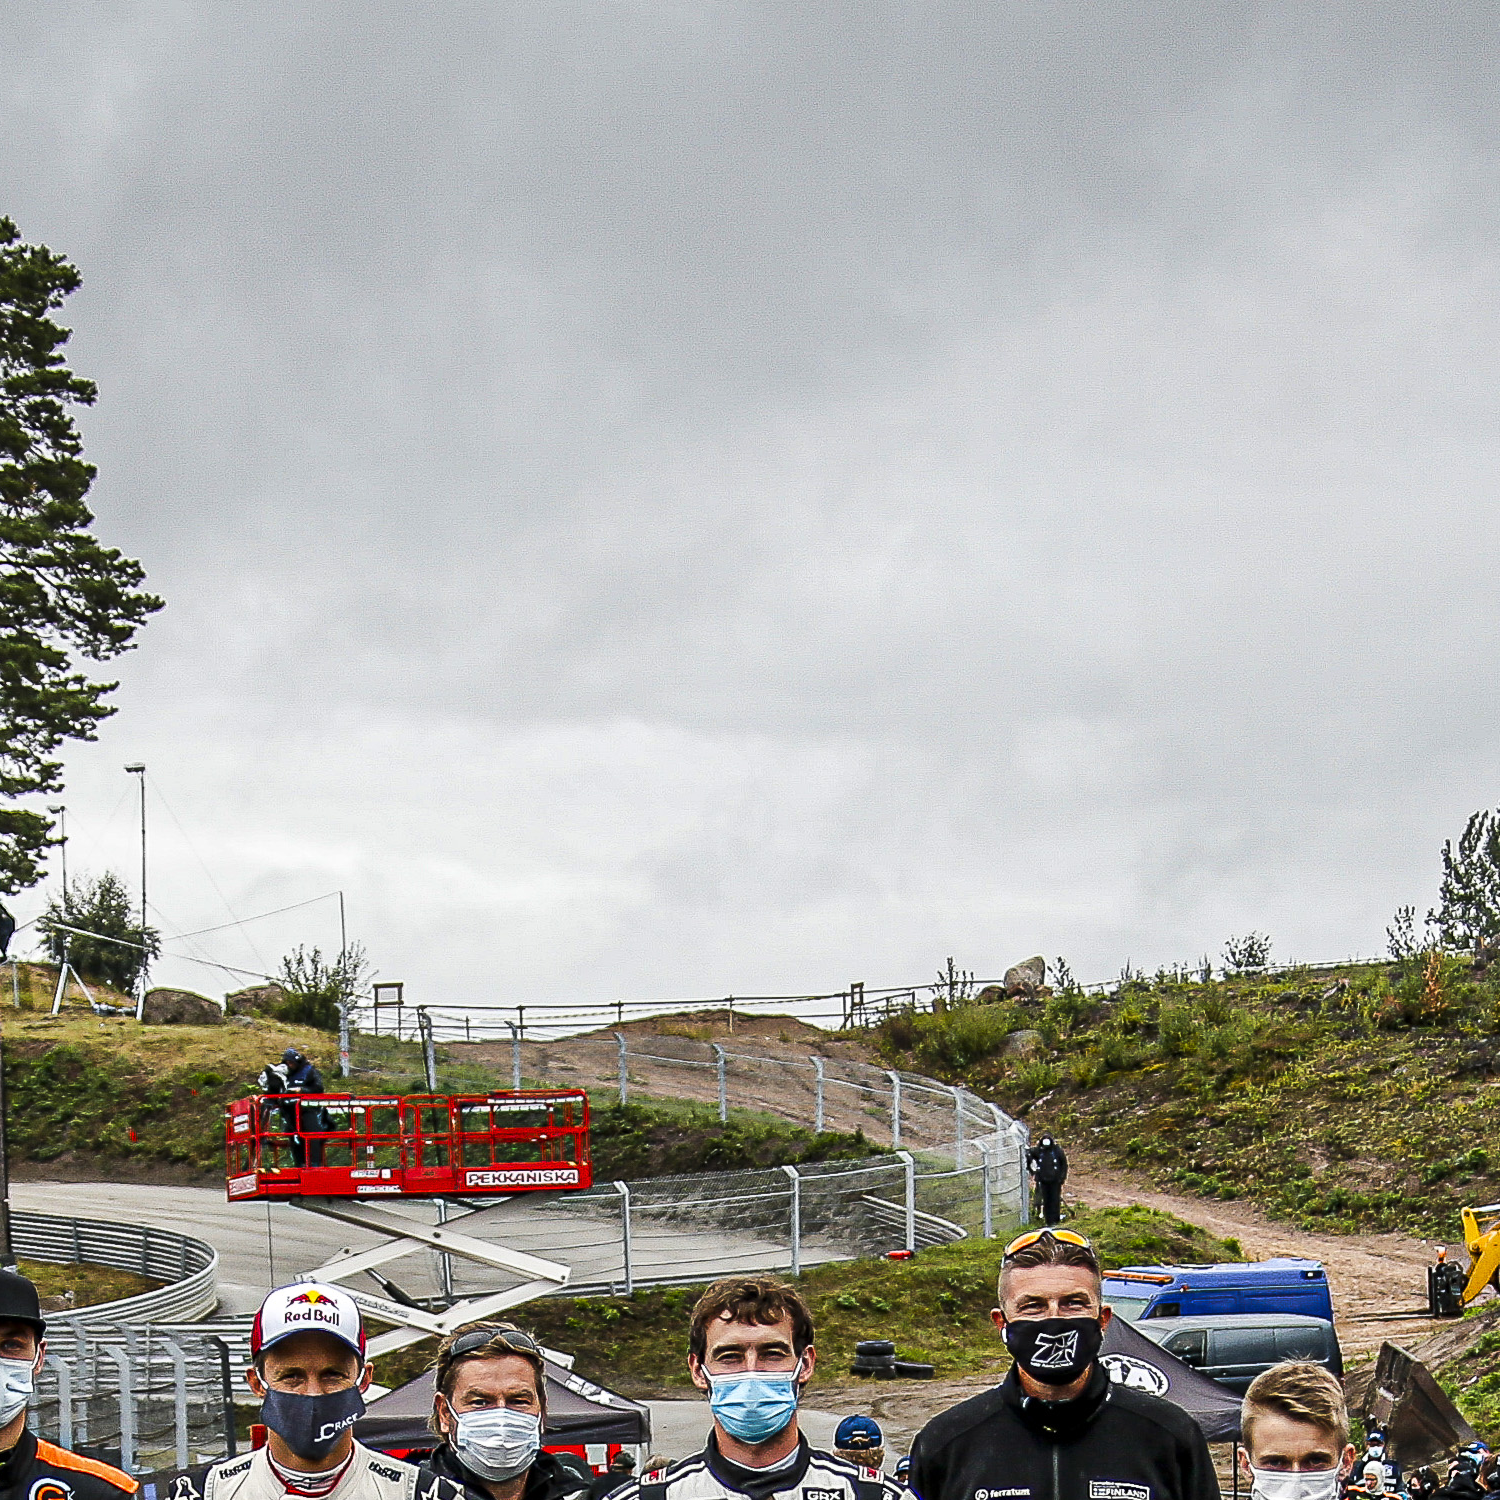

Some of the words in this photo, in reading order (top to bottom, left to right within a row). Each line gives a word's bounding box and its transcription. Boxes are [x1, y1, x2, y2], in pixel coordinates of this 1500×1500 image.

[467, 1169, 579, 1187] PEKKANISKA
[283, 1307, 312, 1325] Red
[313, 1309, 340, 1327] Bull
[990, 1488, 1031, 1498] ferratum
